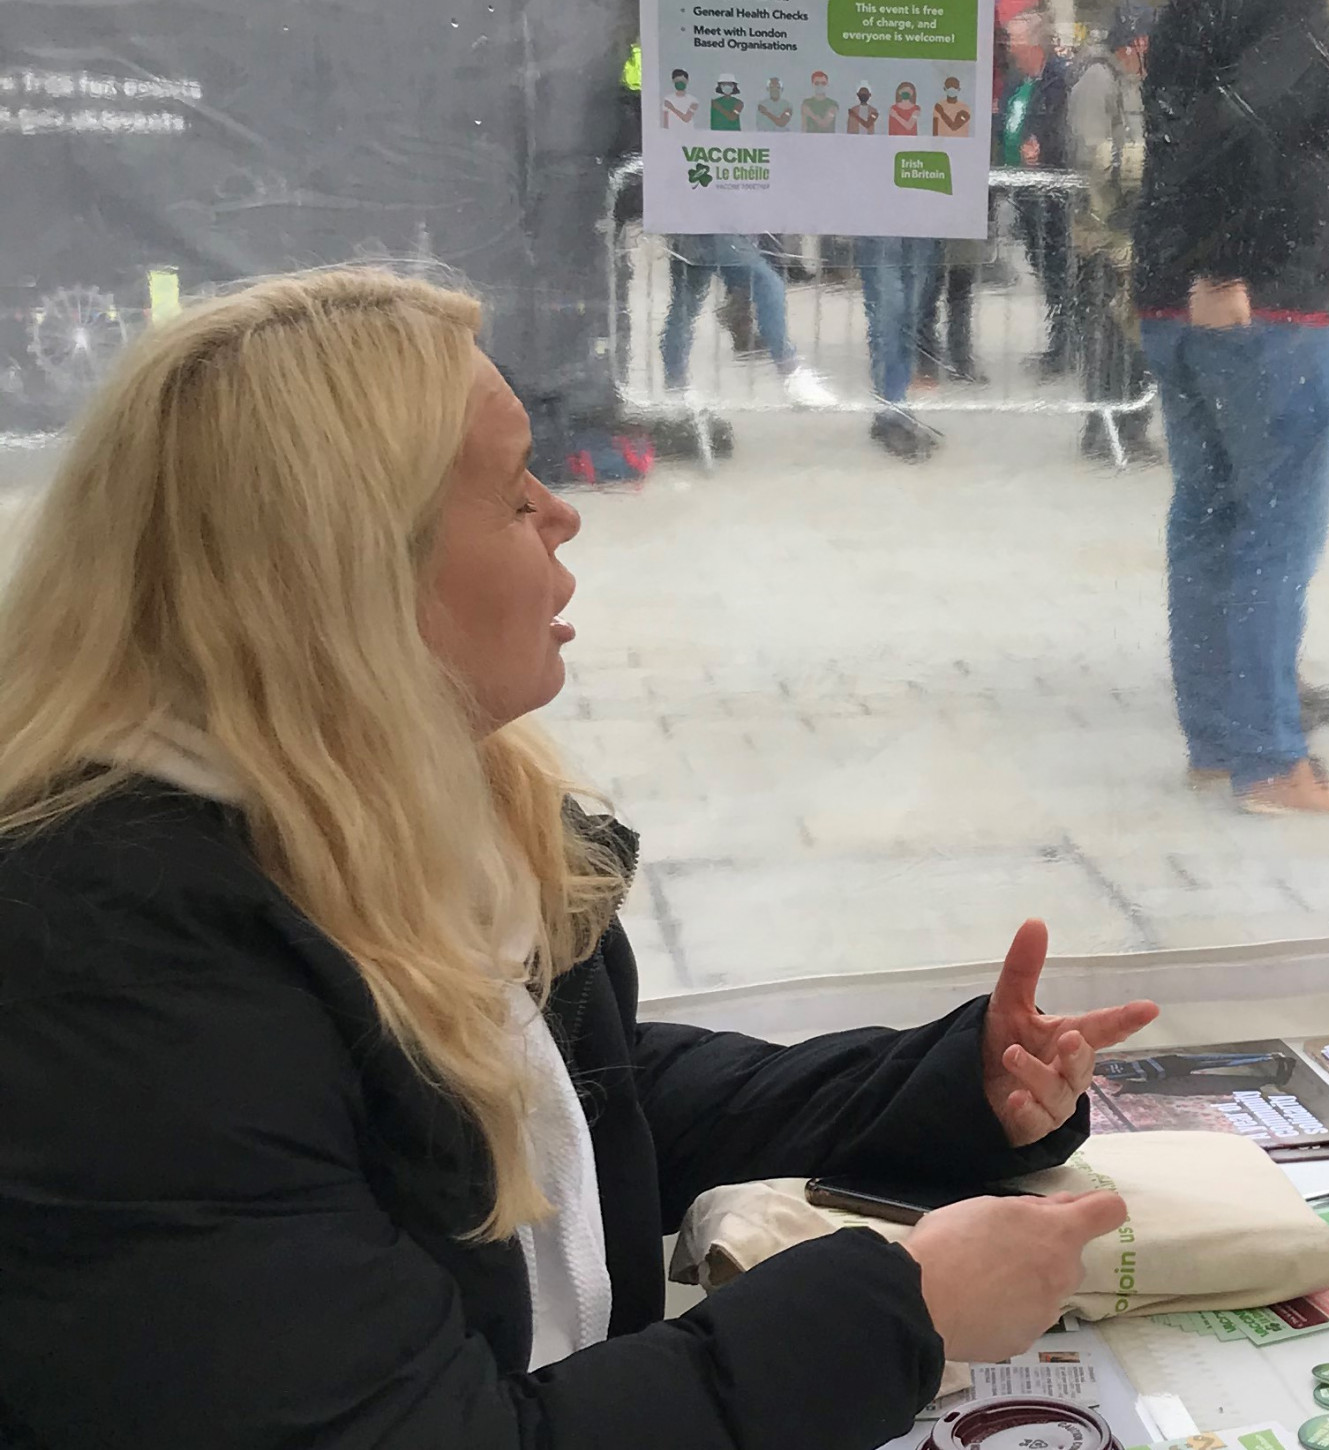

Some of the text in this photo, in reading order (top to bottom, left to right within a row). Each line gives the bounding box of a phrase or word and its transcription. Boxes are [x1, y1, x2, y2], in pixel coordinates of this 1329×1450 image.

[693, 6, 808, 21] General Health Checks
[856, 3, 944, 16] This event is free
[862, 17, 937, 30] of charge, and
[693, 25, 787, 38] Meet with London
[842, 31, 955, 43] everyone is welcome!
[694, 38, 797, 51] Based Organisations
[682, 146, 770, 163] VACCINE
[901, 159, 923, 168] Irish
[716, 165, 770, 181] Le Chéile
[901, 169, 945, 179] in Britain
[1119, 1227, 1136, 1243] us
